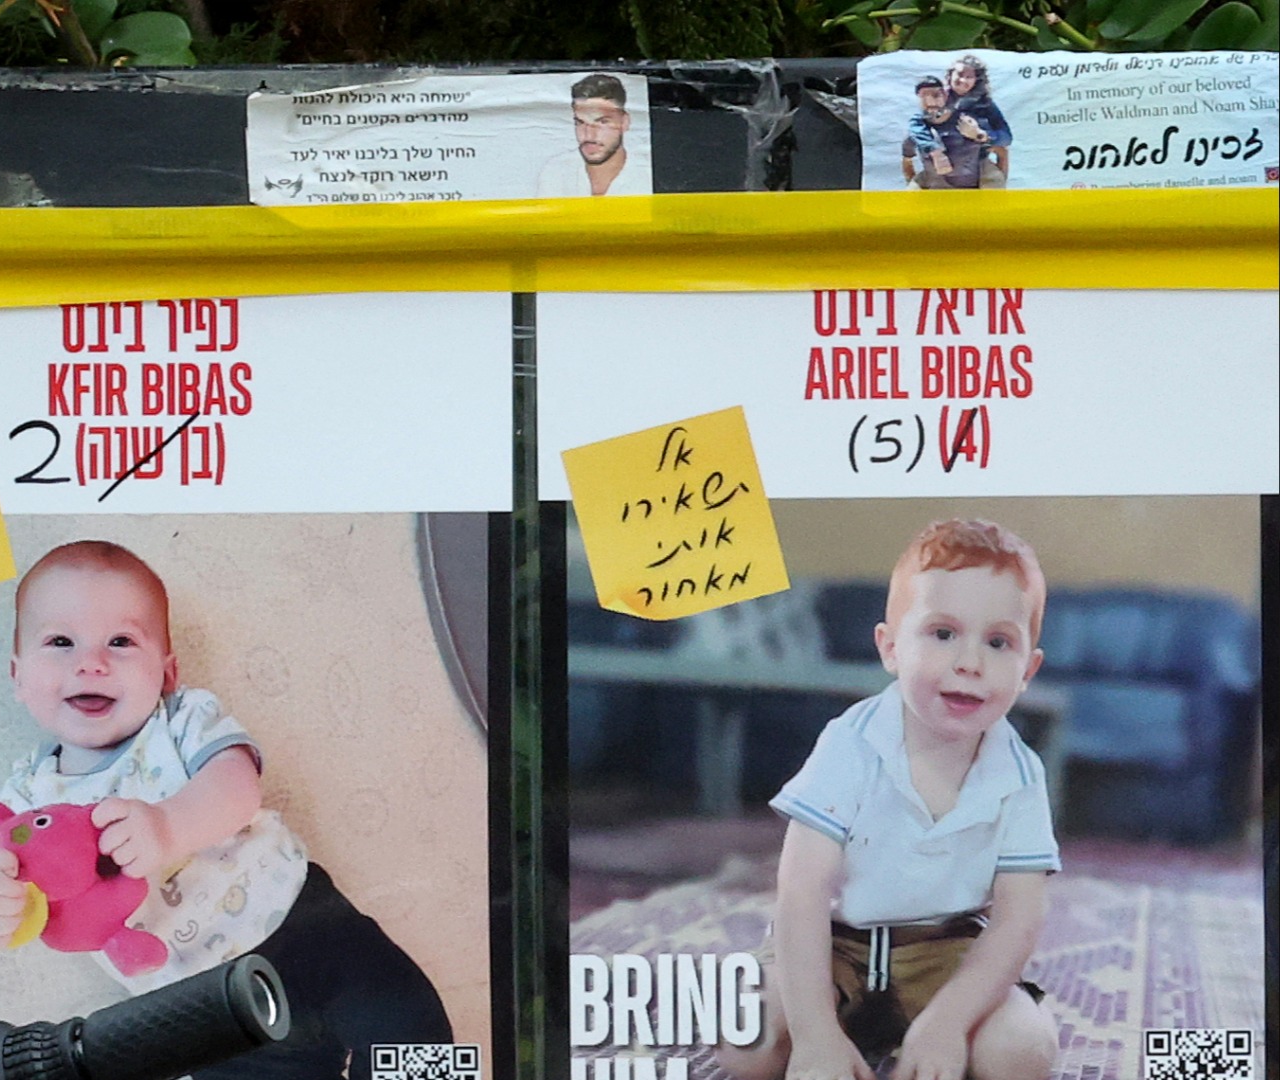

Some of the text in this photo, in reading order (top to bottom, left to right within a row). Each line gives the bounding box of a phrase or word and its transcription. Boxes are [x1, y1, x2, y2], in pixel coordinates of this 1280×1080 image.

[1125, 56, 1164, 70] דניאל
[339, 90, 386, 104] היכולת
[391, 92, 416, 104] היא
[1067, 75, 1251, 101] In memory of our beloved
[347, 113, 400, 126] הקטנים
[405, 112, 469, 123] מהדברים
[1037, 107, 1097, 125] Danielle
[1101, 104, 1169, 120] Waldman
[1173, 100, 1198, 116] and
[1202, 99, 1246, 113] Noam
[289, 145, 476, 162] החיוך שלך בליבנו יאיר לעד
[1062, 125, 1263, 171] זכינו לאהוב
[320, 169, 448, 185] תישאר רוקד לנצח
[1207, 174, 1227, 186] and
[331, 191, 360, 203] שלום
[813, 288, 1026, 337] אריאל ביבס
[60, 299, 239, 353] כפיר ביבס
[803, 344, 1033, 400] ARIEL BIBAS
[47, 362, 252, 417] KFIR BIBAS
[9, 420, 71, 483] 2
[655, 426, 695, 473] אל
[848, 414, 925, 473] (5)
[637, 562, 753, 608] מאחור
[568, 952, 762, 1047] BRING
